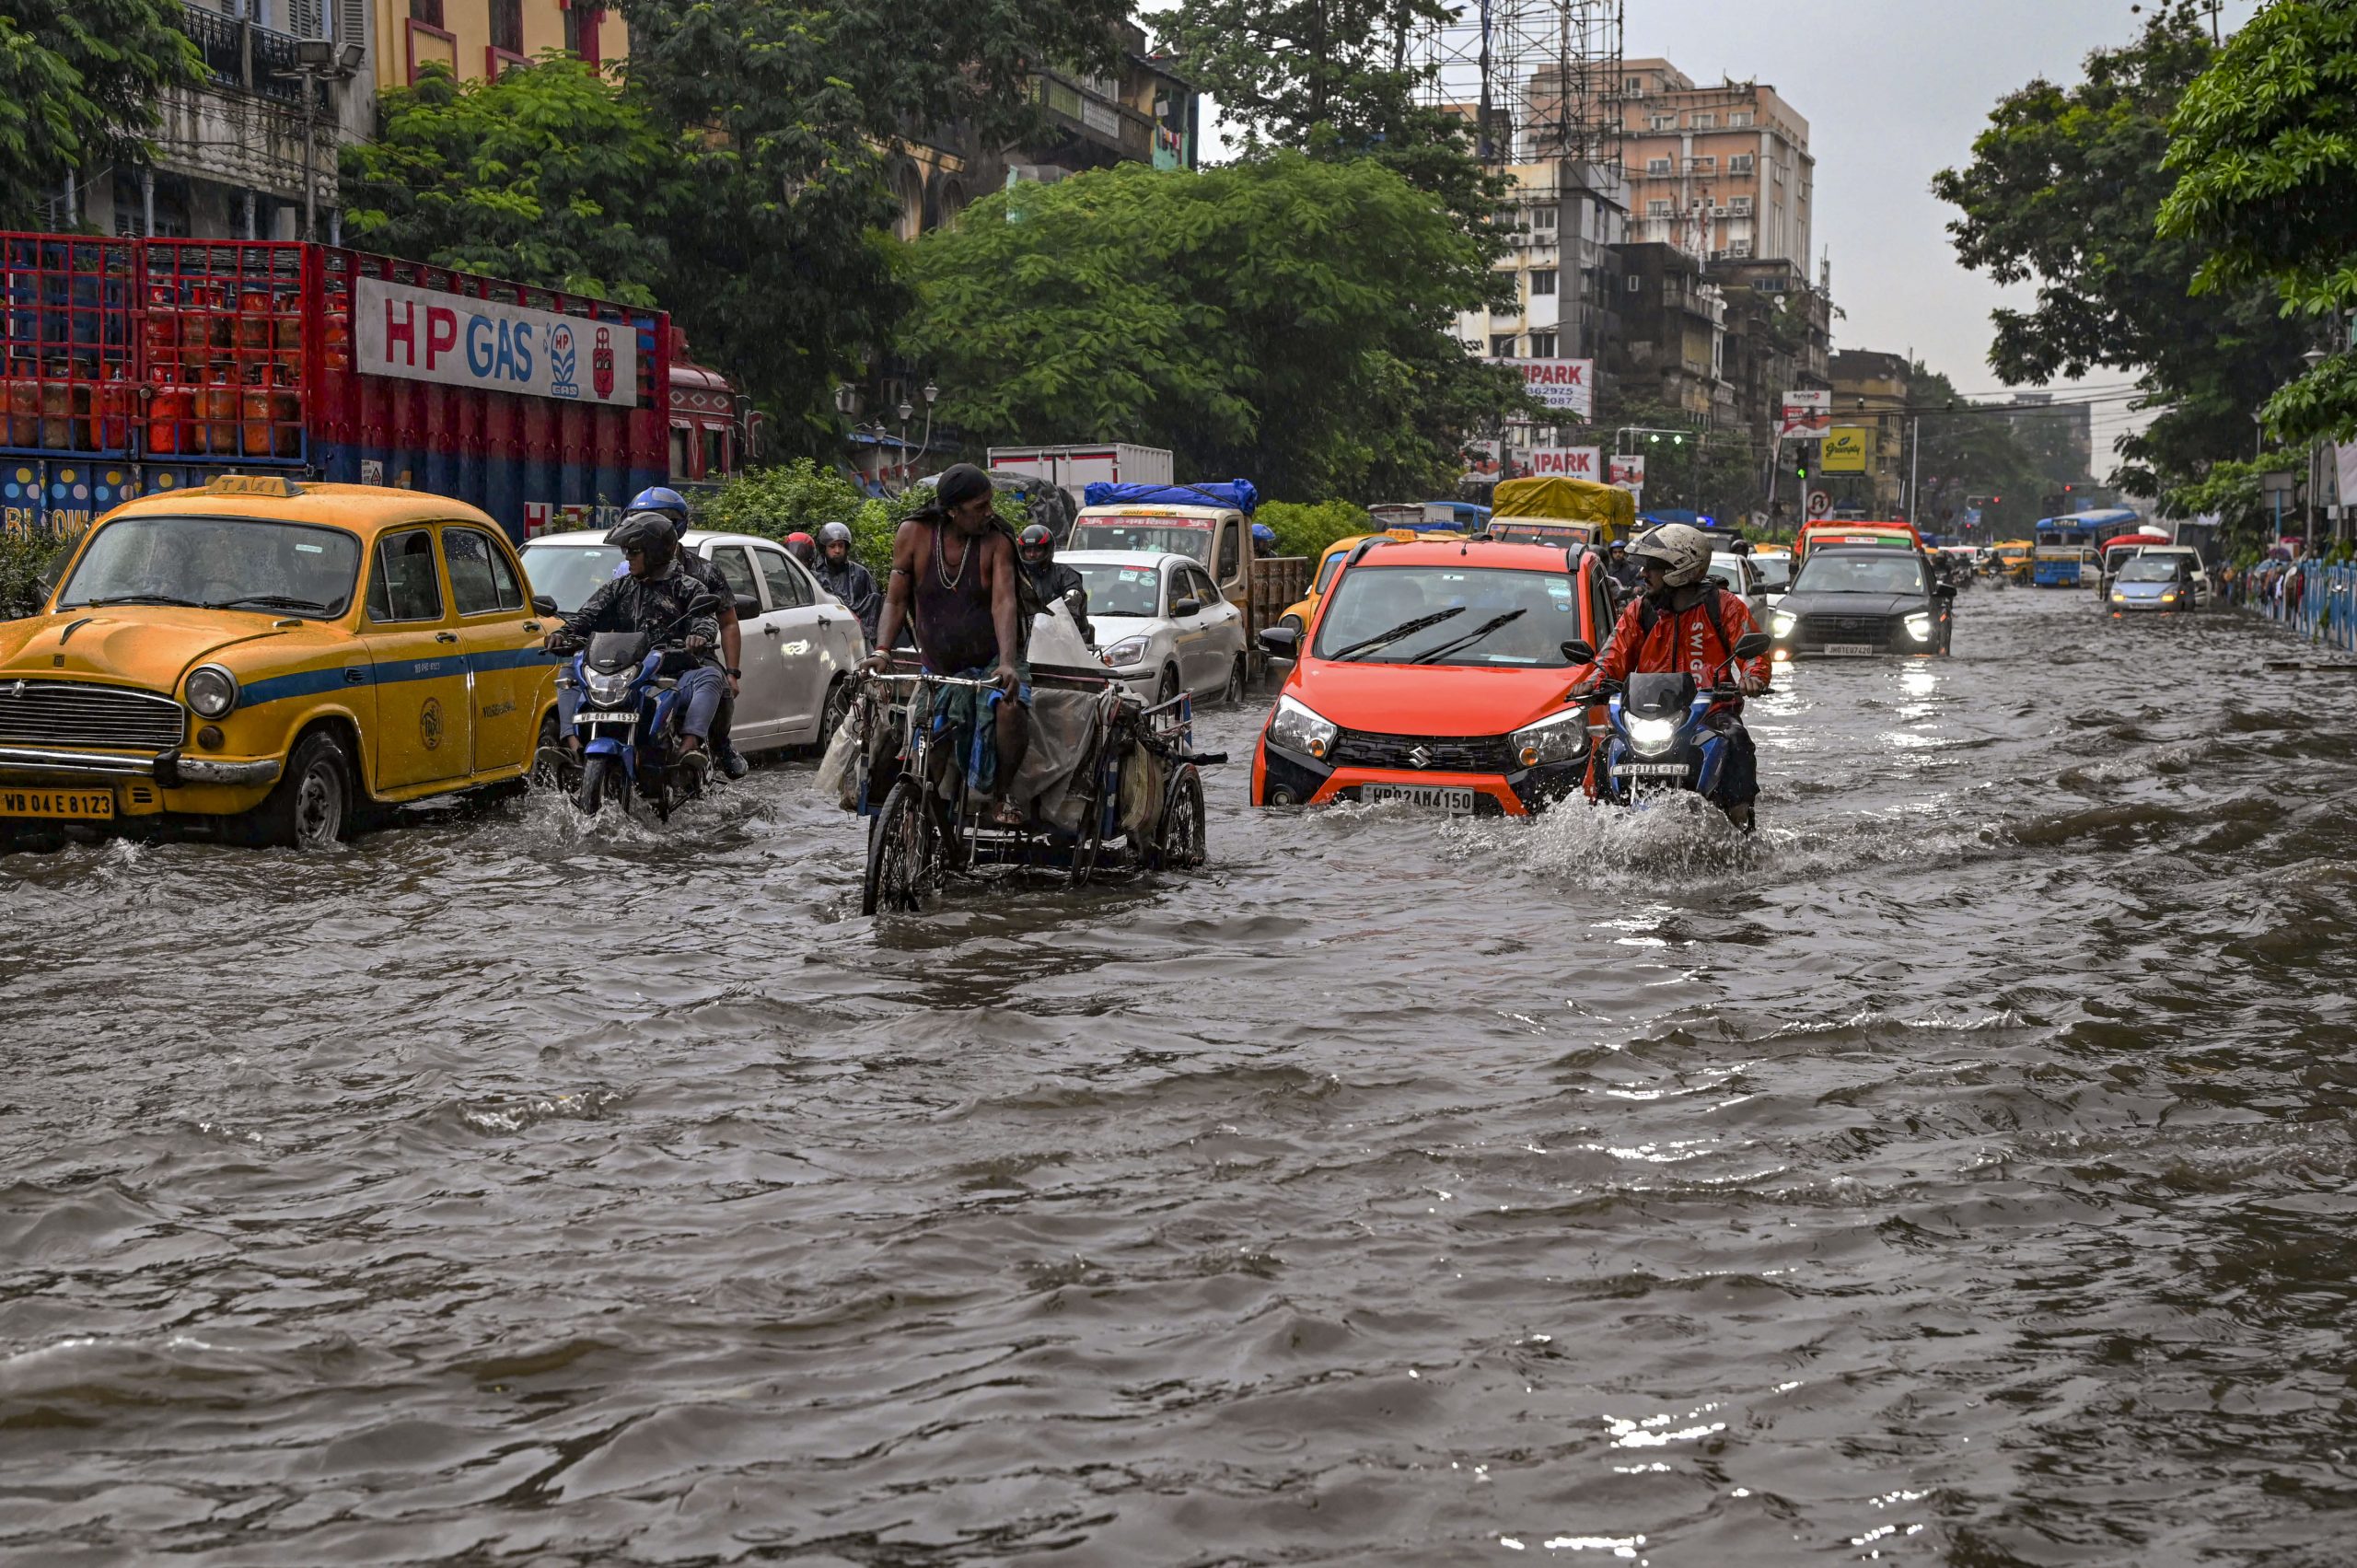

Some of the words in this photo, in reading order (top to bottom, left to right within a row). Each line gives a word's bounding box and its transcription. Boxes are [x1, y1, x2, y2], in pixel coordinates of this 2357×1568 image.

[385, 298, 457, 371] HP
[467, 314, 532, 383] GAS
[555, 334, 569, 350] HP
[553, 386, 577, 396] GAS
[222, 479, 279, 493] TAXI
